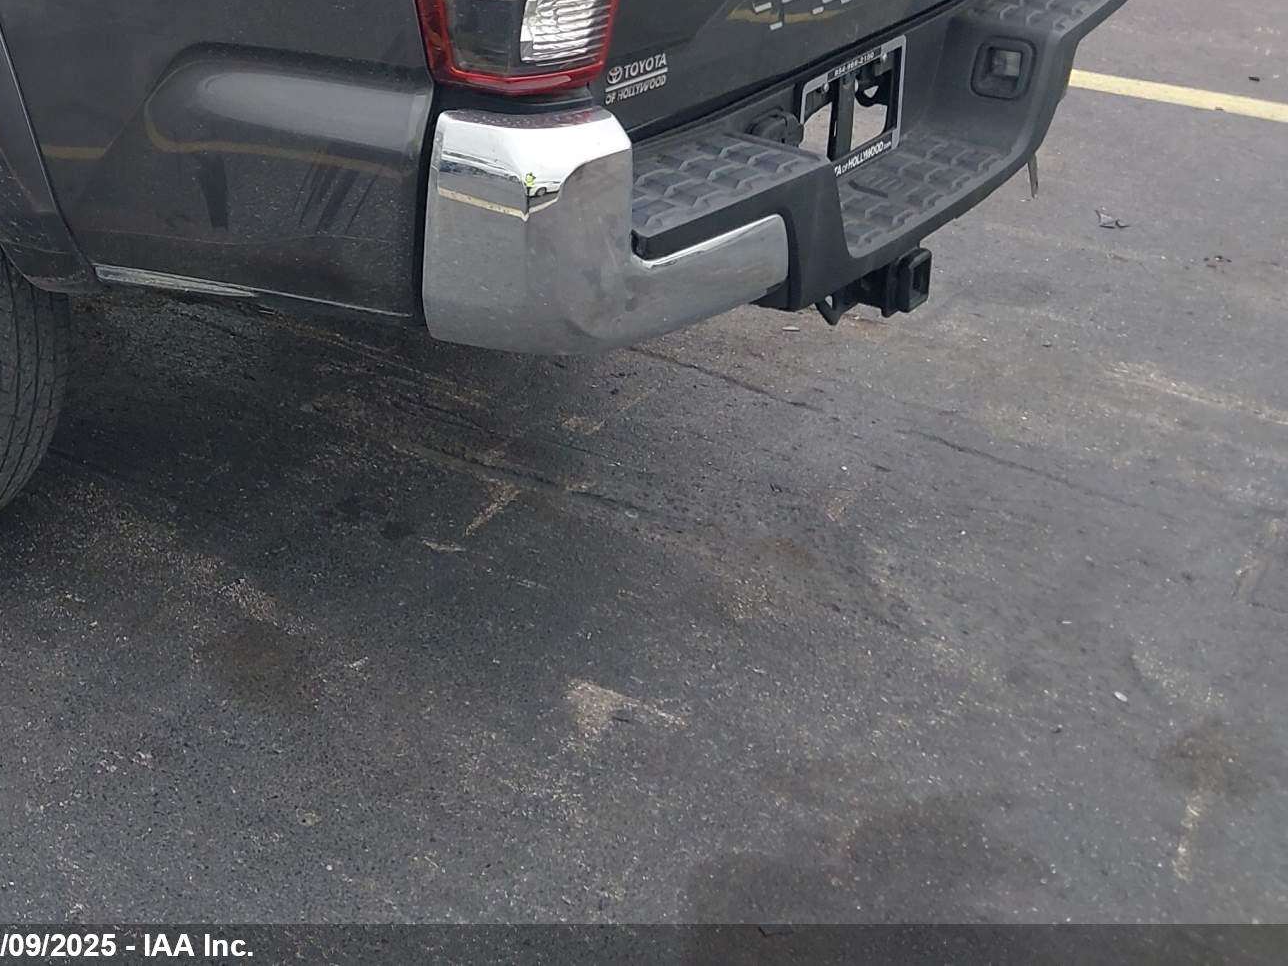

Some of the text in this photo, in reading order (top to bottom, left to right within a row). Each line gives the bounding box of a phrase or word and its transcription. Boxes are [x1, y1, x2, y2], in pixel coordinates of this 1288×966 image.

[624, 52, 667, 79] TOYOTA
[605, 74, 667, 106] OF HOLLYWOOD
